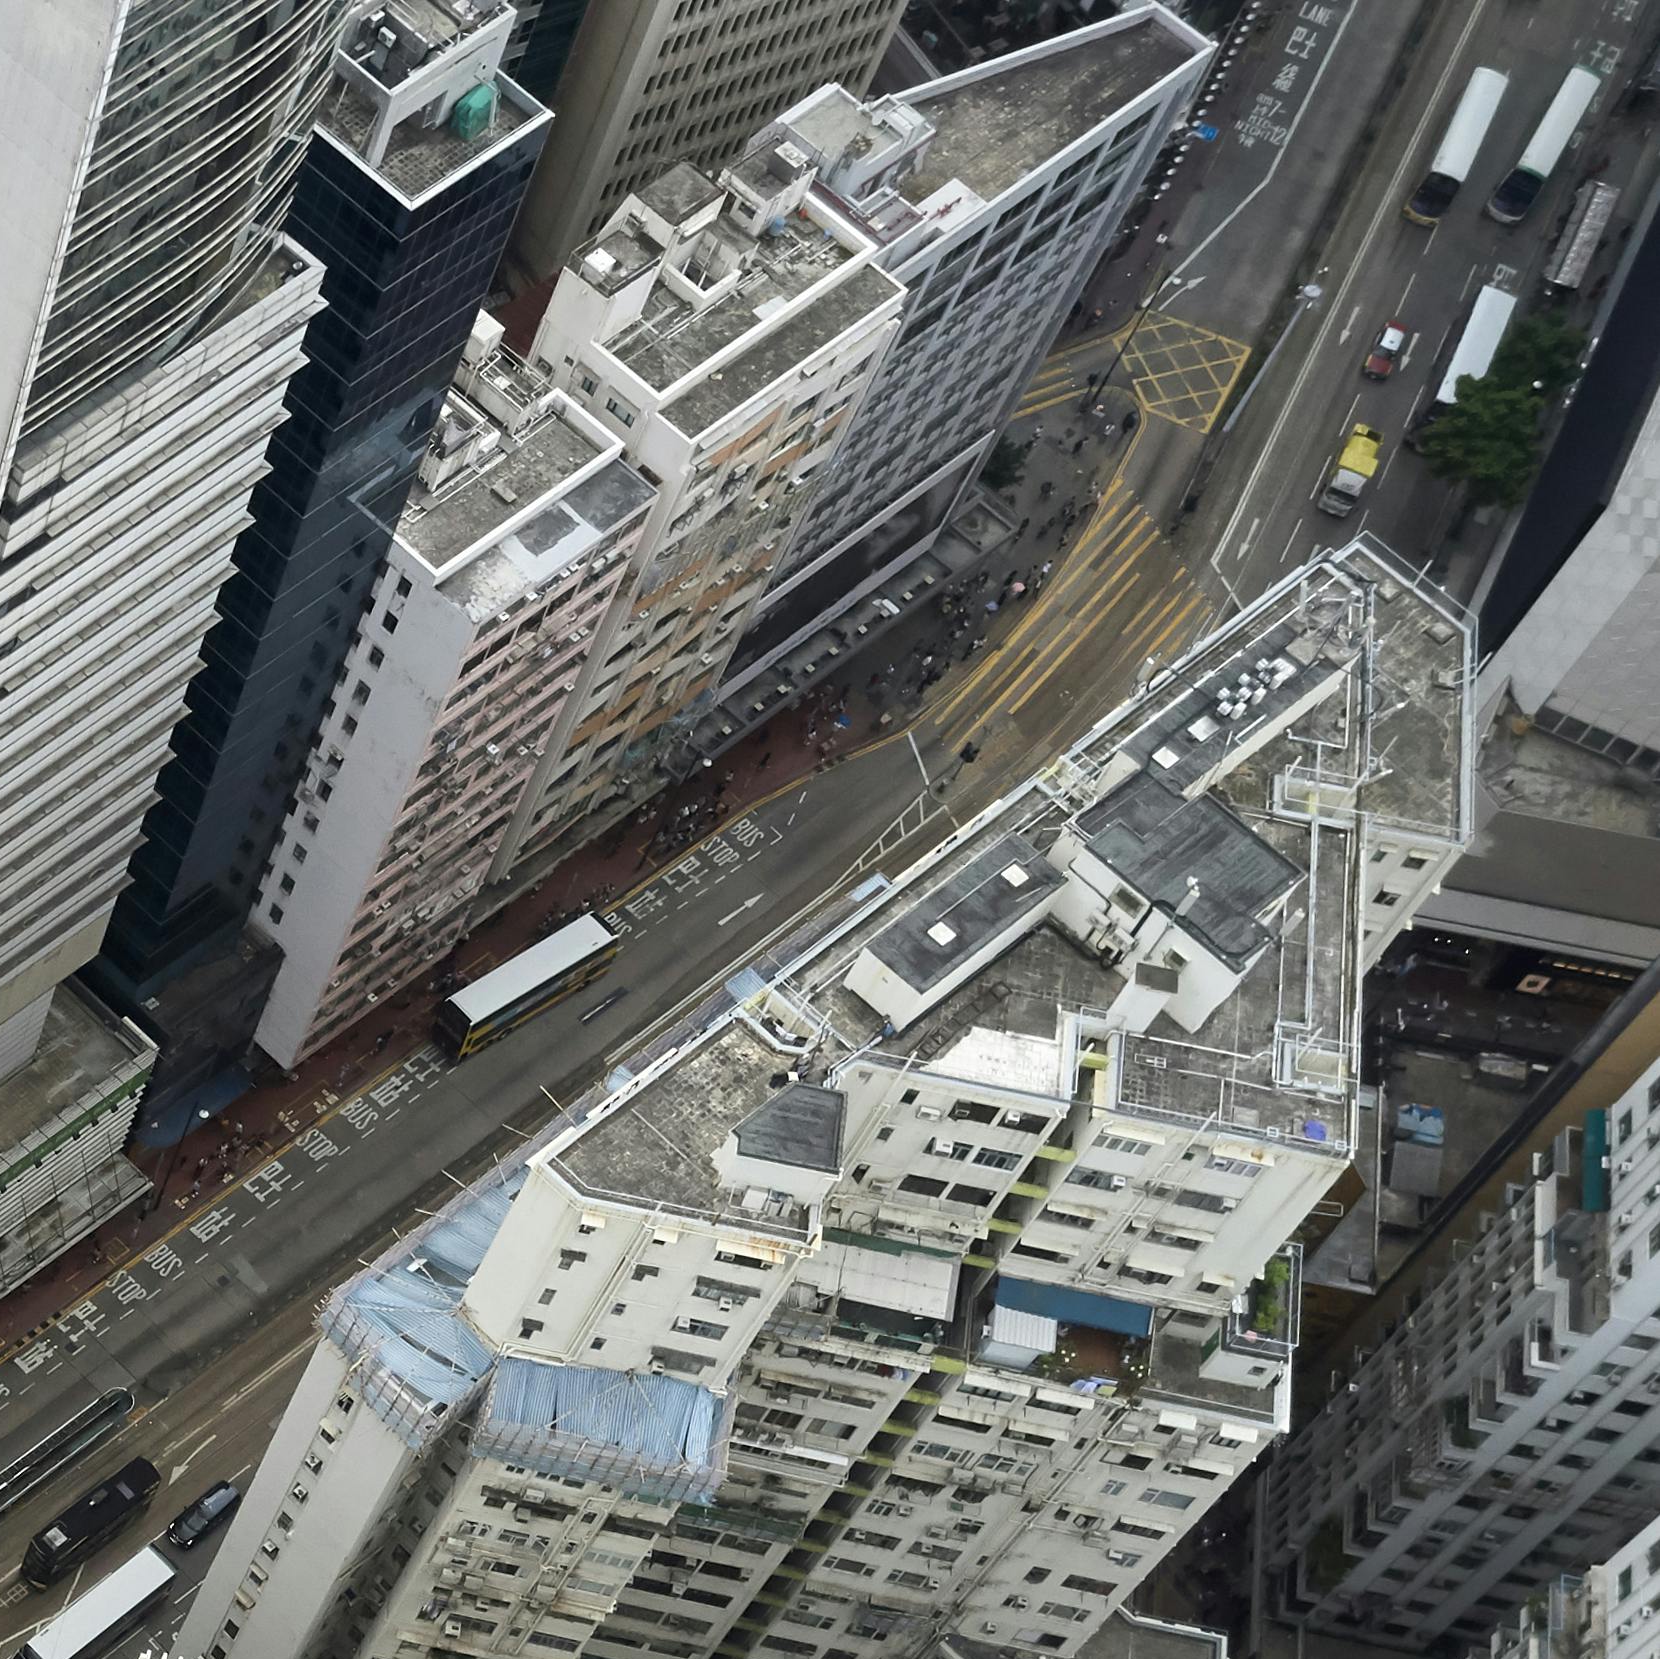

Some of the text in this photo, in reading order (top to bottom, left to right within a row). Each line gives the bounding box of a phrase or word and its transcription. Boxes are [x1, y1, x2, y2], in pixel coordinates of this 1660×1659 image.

[1298, 1, 1331, 27] LANE
[1285, 26, 1317, 59] 巴士
[1590, 40, 1622, 75] 巴士
[730, 817, 765, 848] BUS
[700, 836, 740, 866] STOP
[662, 855, 709, 894] 巴士
[624, 887, 668, 921] 站
[402, 1043, 447, 1082] 巴士
[368, 1073, 414, 1108] 站
[339, 1096, 379, 1131] BUS
[295, 1127, 339, 1162] STOP
[242, 1160, 292, 1203] 巴士
[189, 1206, 237, 1244] 站
[143, 1243, 183, 1278] BUS
[105, 1269, 148, 1306] STOP
[56, 1300, 106, 1343] 巴士
[13, 1338, 59, 1375] 站
